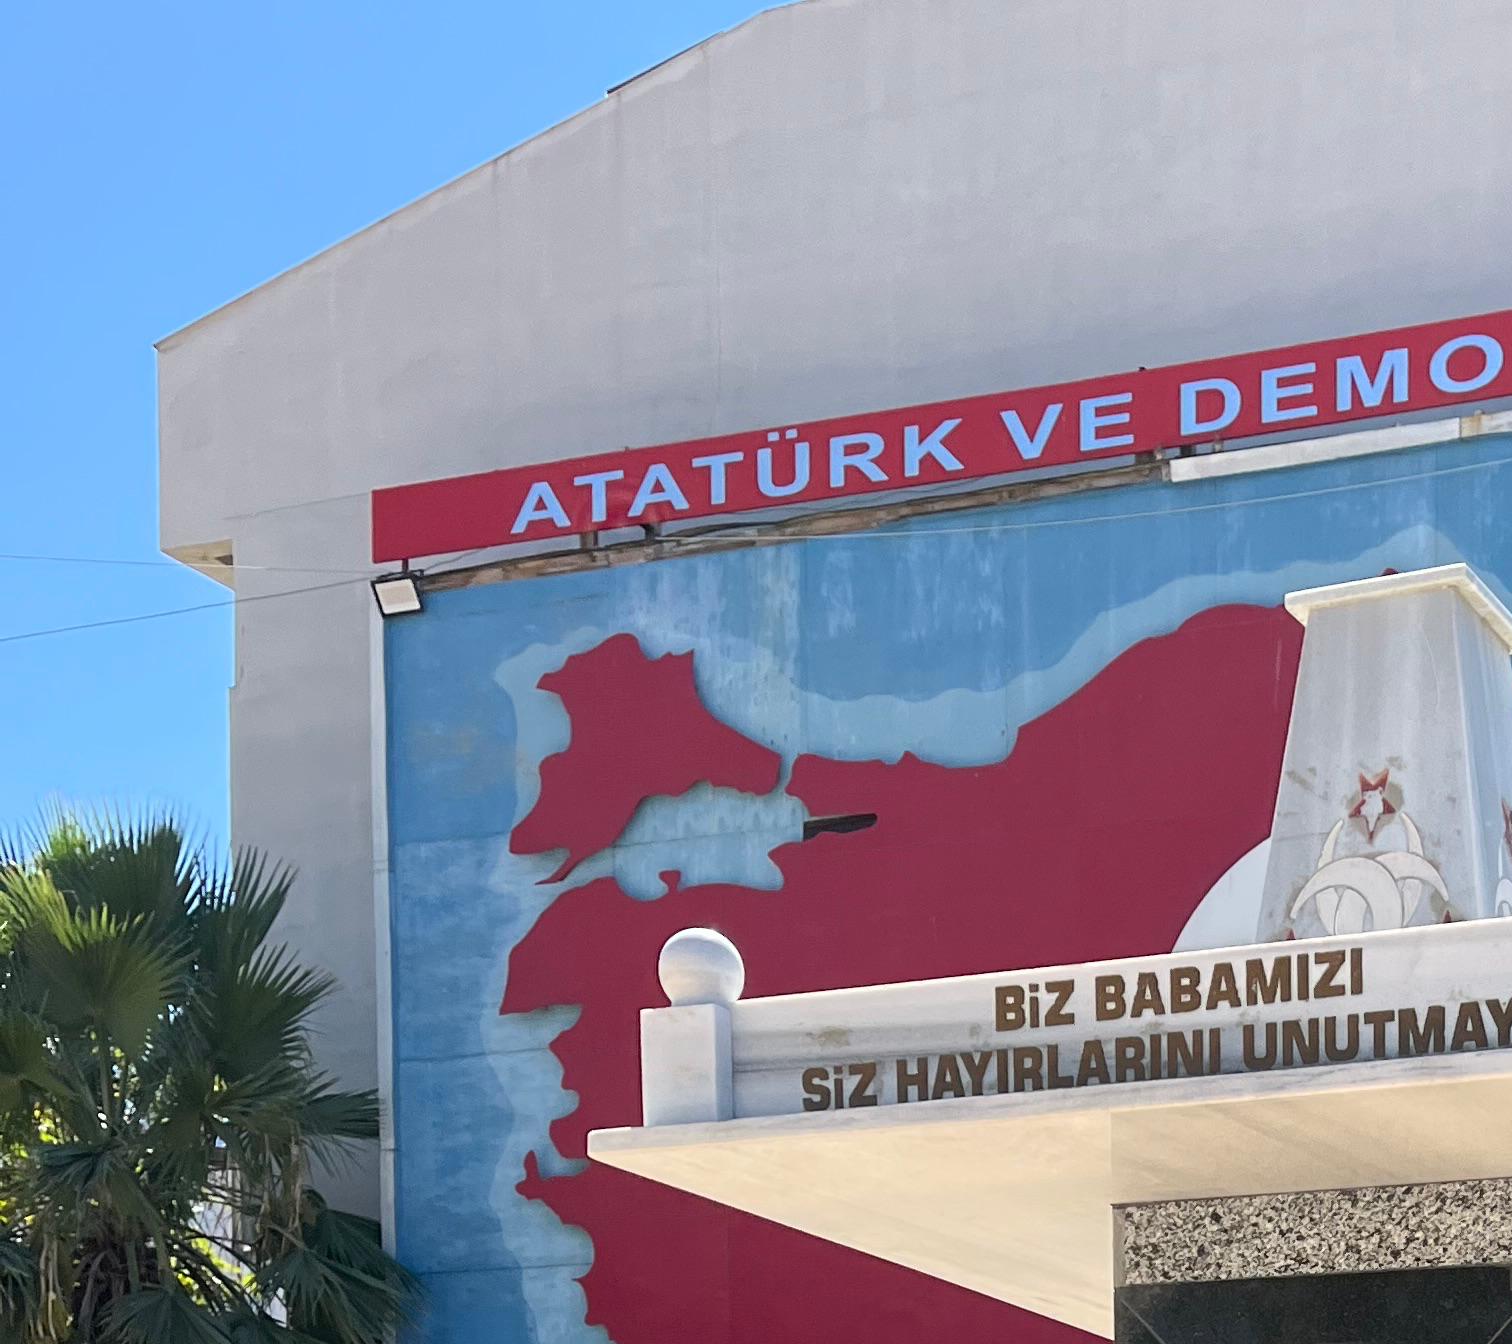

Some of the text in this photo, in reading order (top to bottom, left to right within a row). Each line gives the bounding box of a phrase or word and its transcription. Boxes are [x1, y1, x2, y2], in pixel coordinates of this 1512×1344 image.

[508, 416, 964, 536] ATATÜRK
[1000, 390, 1136, 462] VE
[1095, 947, 1365, 1022] BABAMIZI
[897, 1027, 1222, 1104] HAYIRLARINI
